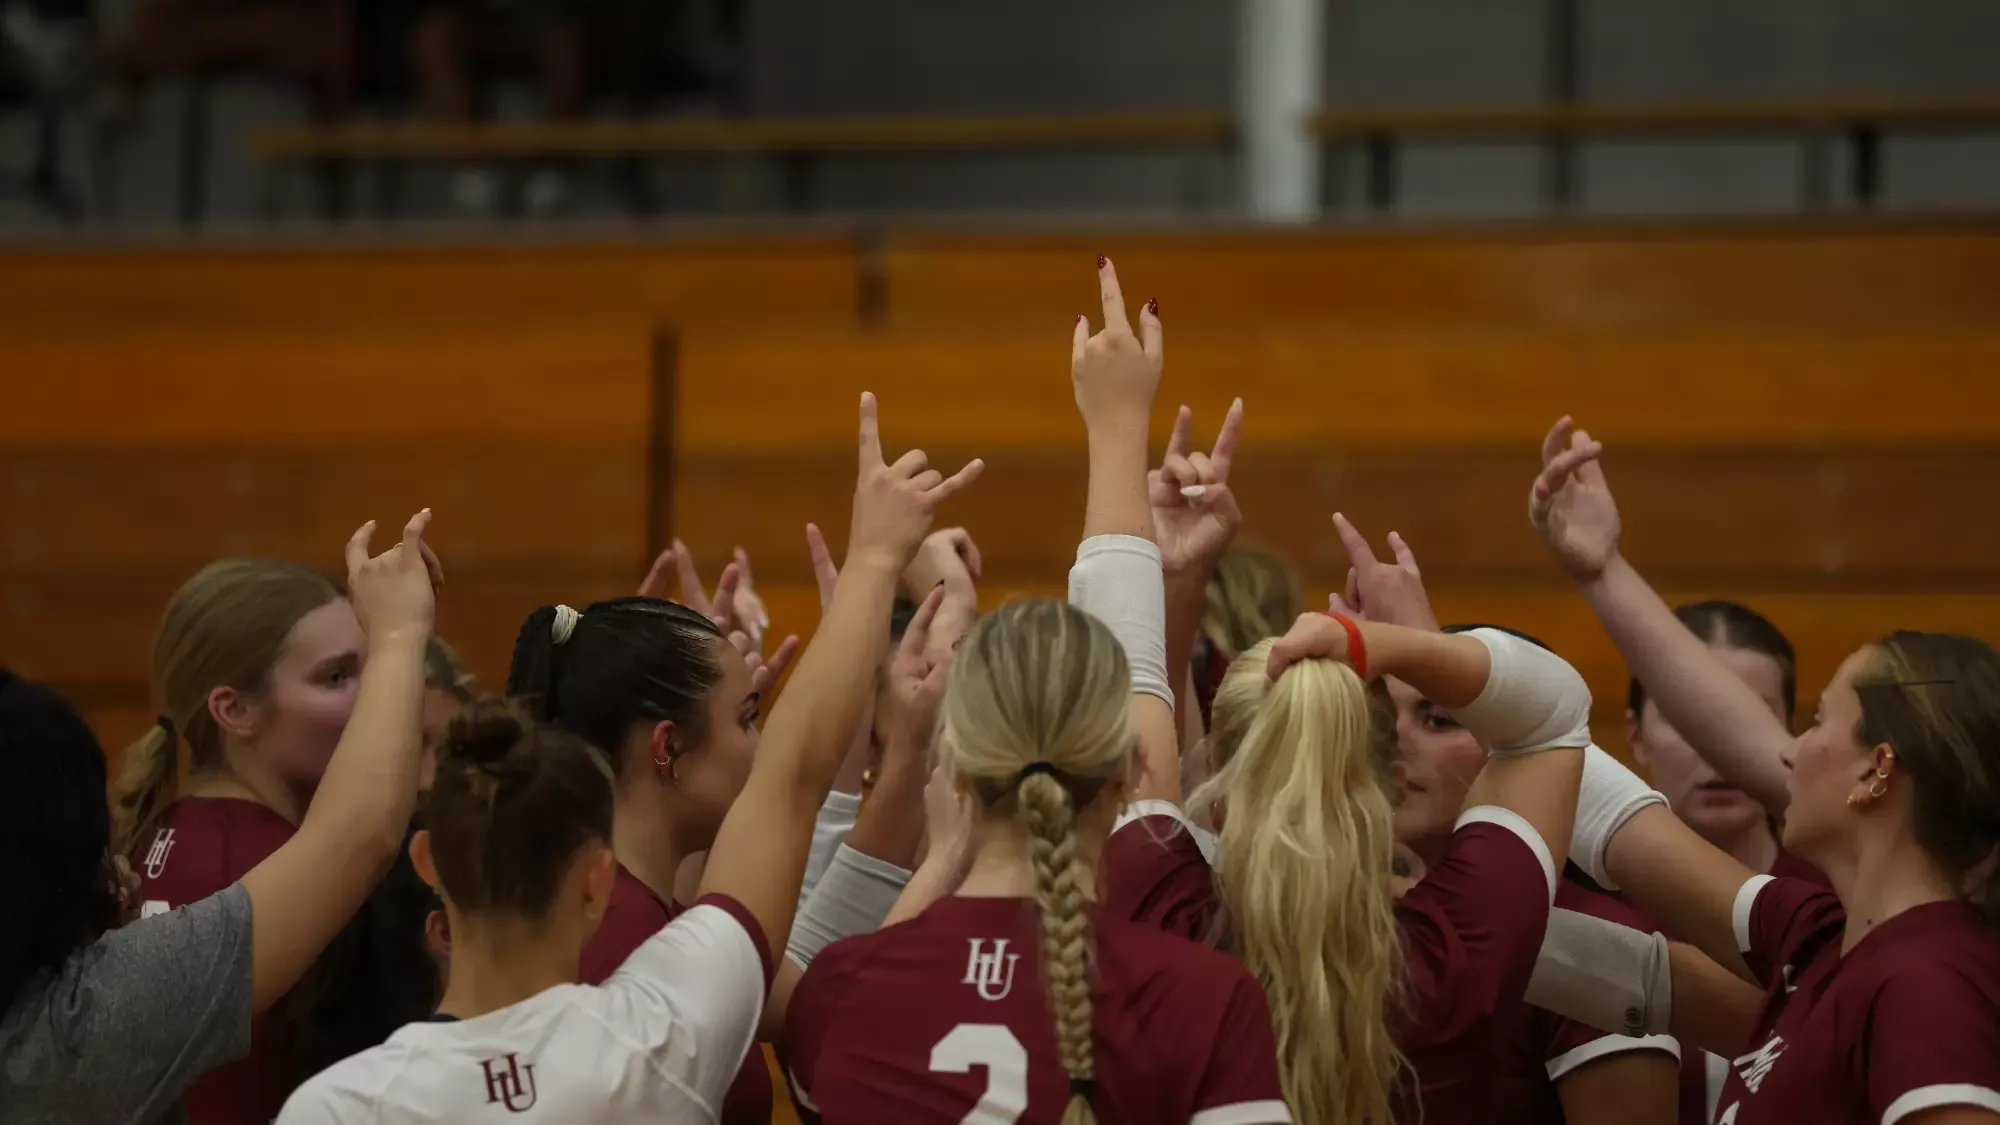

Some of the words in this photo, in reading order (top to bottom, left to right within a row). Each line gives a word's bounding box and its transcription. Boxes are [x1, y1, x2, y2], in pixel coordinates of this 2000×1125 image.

[143, 828, 177, 880] HU
[960, 937, 1023, 1001] HU
[477, 1051, 538, 1113] HU
[928, 1022, 1030, 1125] 2
